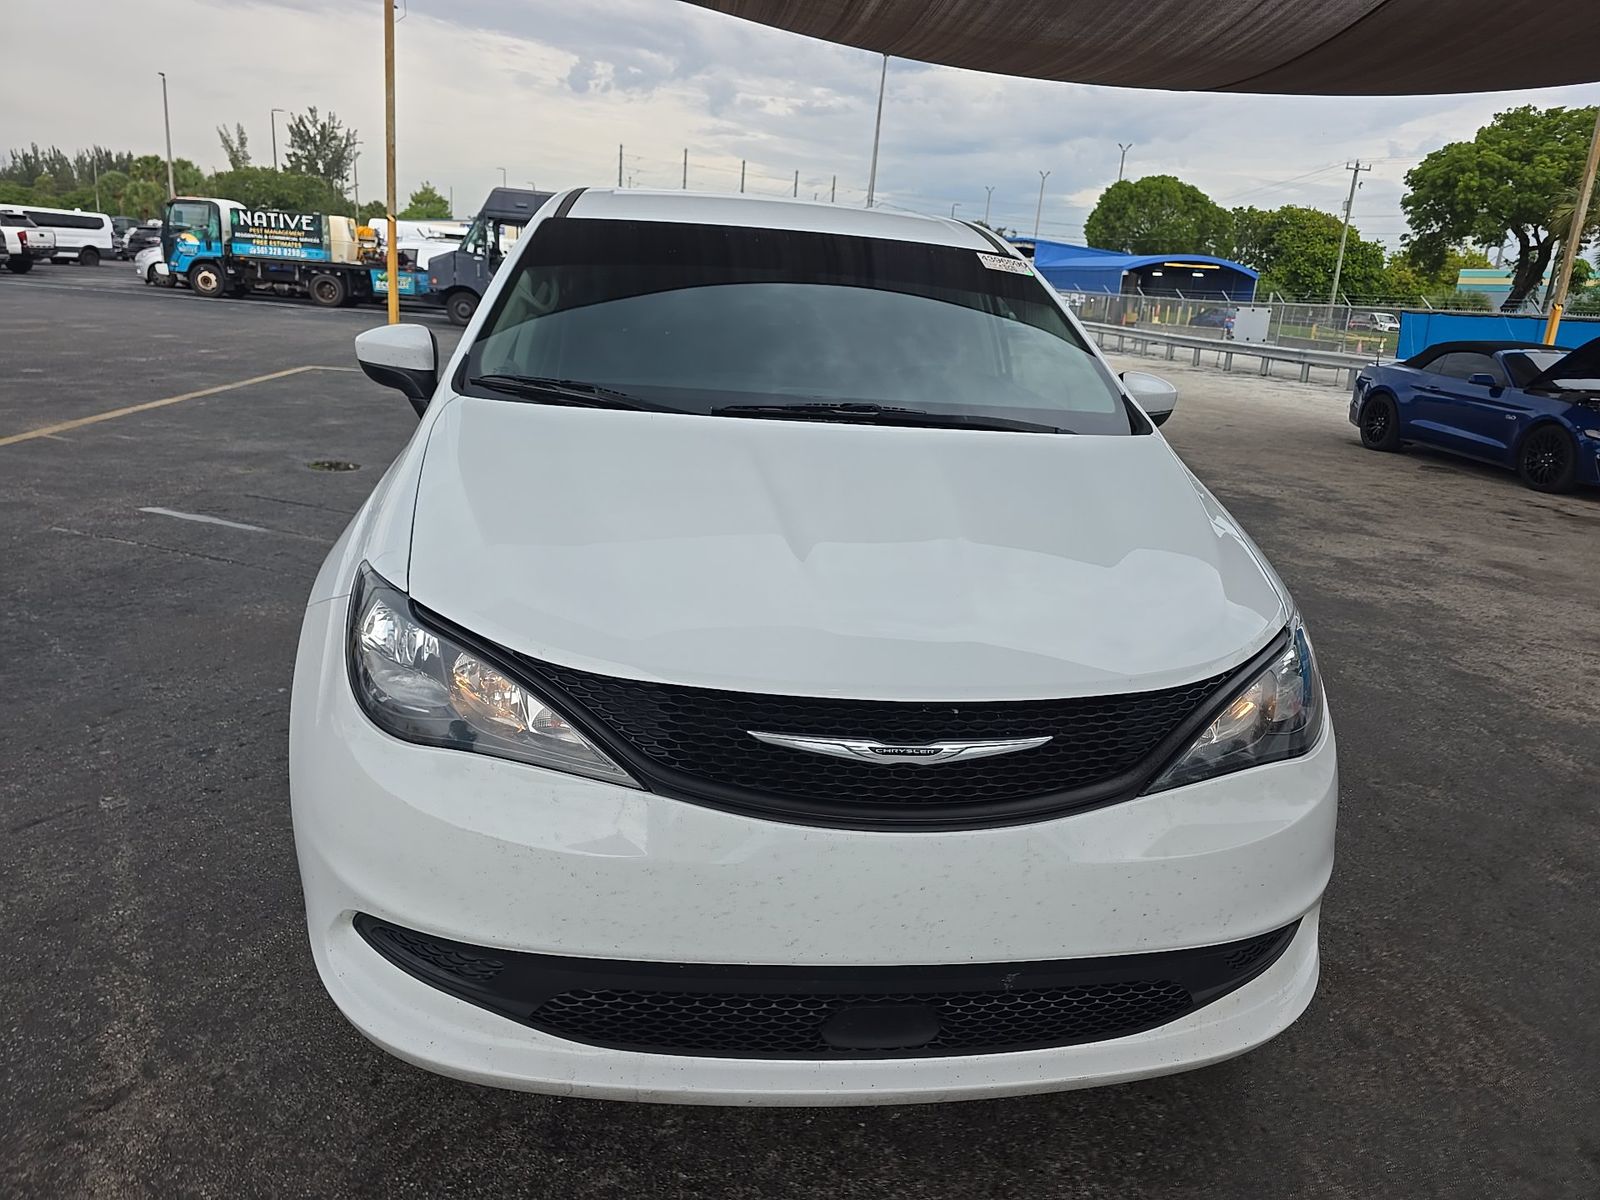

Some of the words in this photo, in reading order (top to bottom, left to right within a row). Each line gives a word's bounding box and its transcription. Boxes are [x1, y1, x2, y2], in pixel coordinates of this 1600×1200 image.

[238, 210, 314, 231] NATIVE
[264, 228, 305, 237] MANAGEMENT
[252, 238, 268, 246] FREE
[269, 239, 302, 248] ESTIMATES
